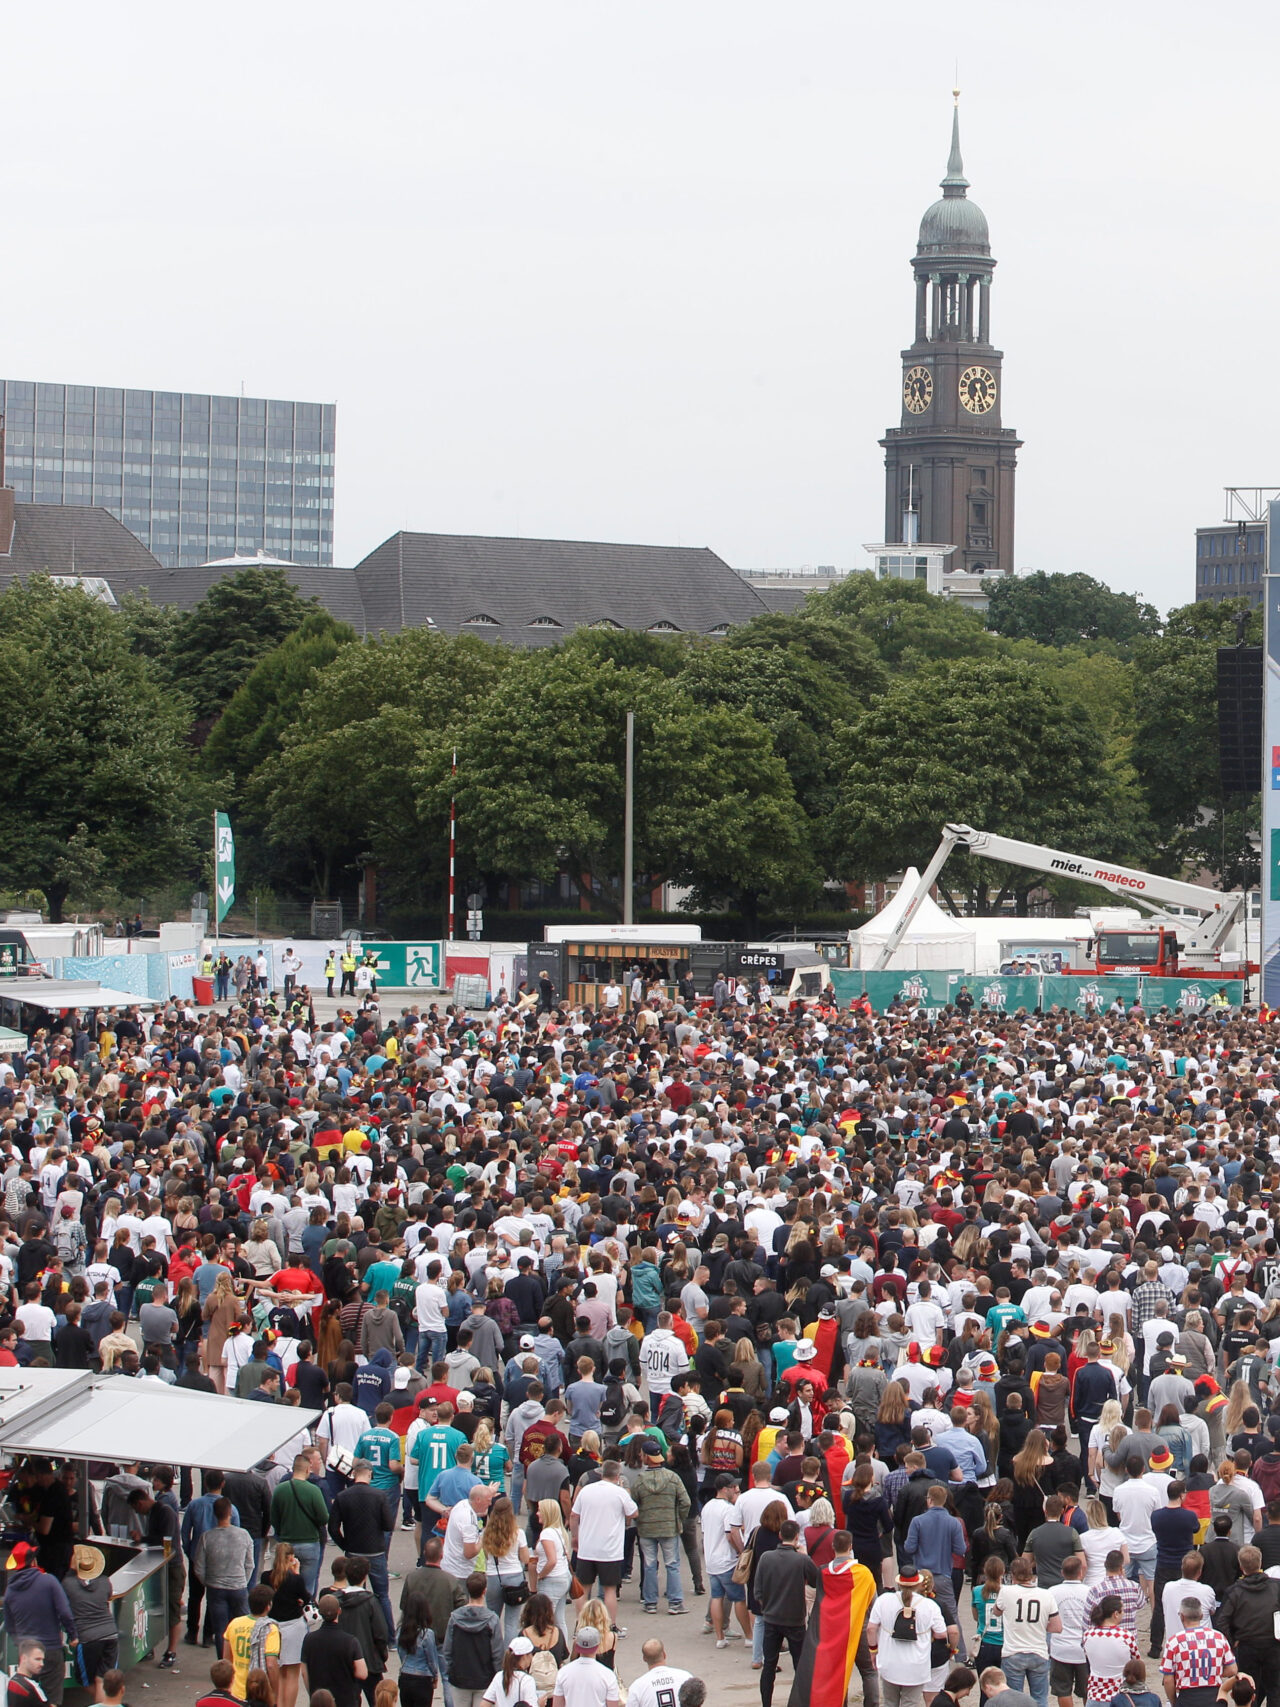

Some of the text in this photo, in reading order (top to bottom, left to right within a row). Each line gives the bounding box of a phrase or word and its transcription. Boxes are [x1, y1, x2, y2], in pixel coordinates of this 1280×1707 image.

[1050, 858, 1146, 890] miet... mateco
[740, 954, 776, 966] CRÊPES
[907, 1190, 914, 1205] 7
[1262, 1266, 1278, 1287] 18
[648, 1350, 670, 1372] 2014
[363, 1436, 390, 1444] HECTOR
[370, 1446, 382, 1466] 3
[430, 1442, 446, 1469] 11
[1014, 1598, 1038, 1623] 10
[1190, 1649, 1212, 1681] 10
